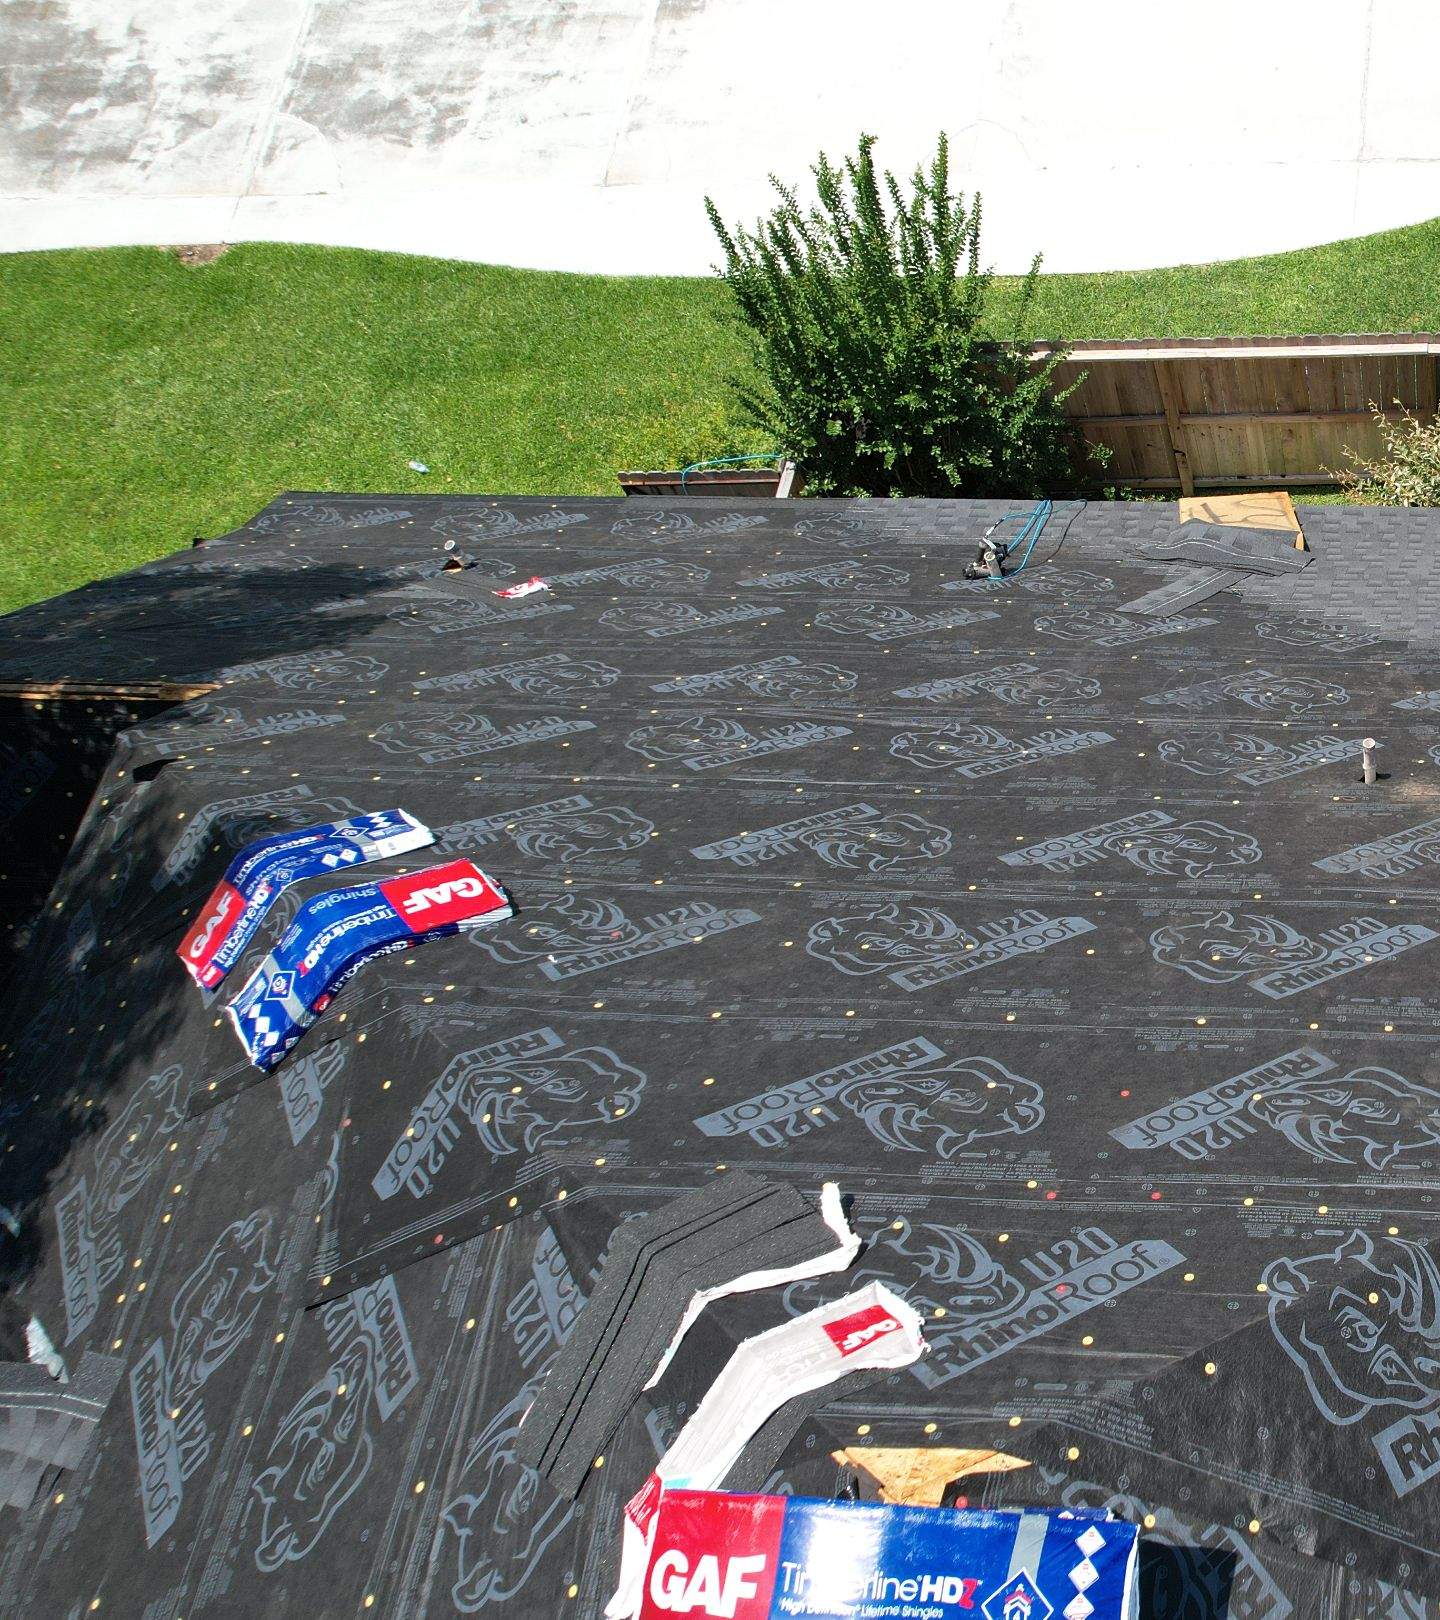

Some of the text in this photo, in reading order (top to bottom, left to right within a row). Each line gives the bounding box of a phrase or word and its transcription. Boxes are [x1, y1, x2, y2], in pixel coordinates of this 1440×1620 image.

[402, 876, 486, 915] GAF
[651, 1548, 768, 1619] GAF
[860, 1604, 900, 1618] Lifetime
[902, 1604, 945, 1620] Shingles
